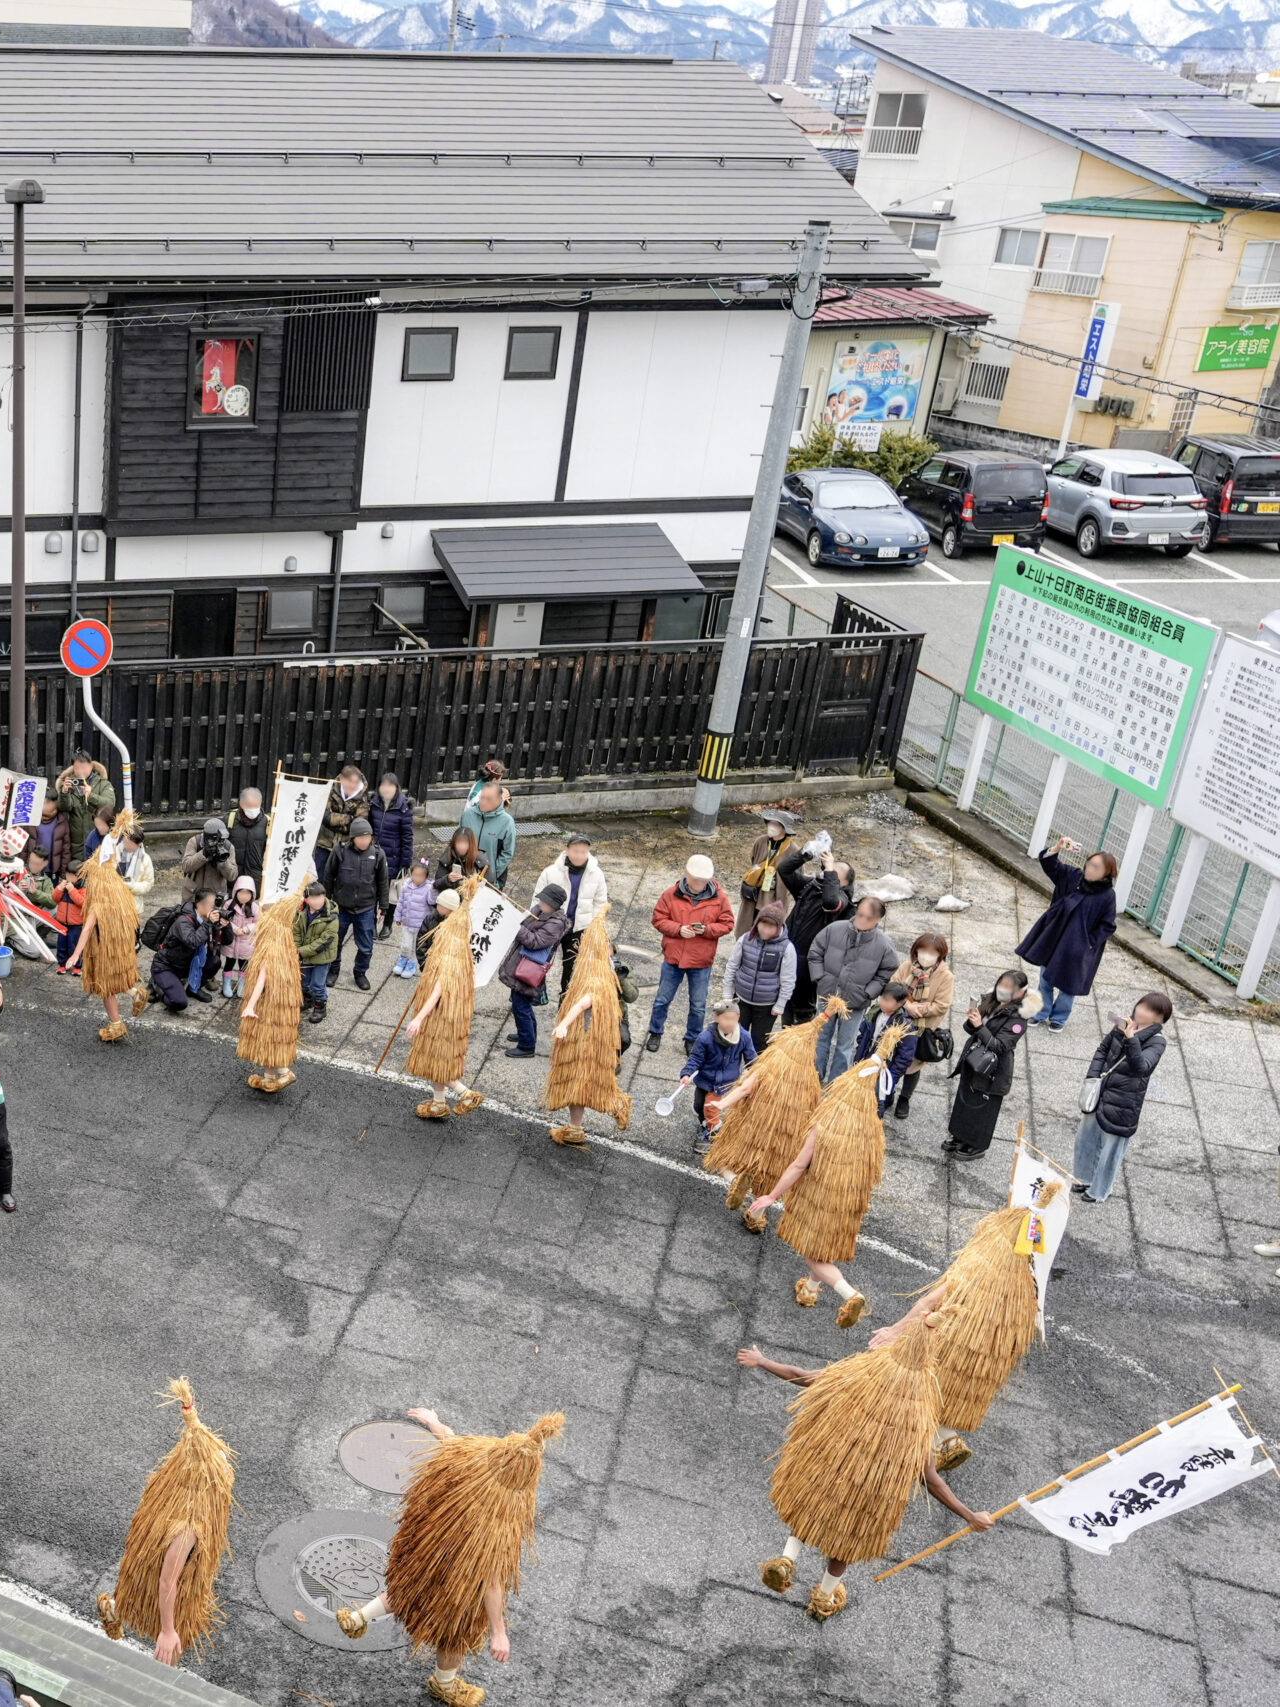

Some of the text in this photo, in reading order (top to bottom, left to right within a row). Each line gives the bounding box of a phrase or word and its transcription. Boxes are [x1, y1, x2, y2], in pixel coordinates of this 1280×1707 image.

[1206, 338, 1270, 357] アライ美容院
[1024, 563, 1186, 643] 上山十日町商店街振興協同組合員
